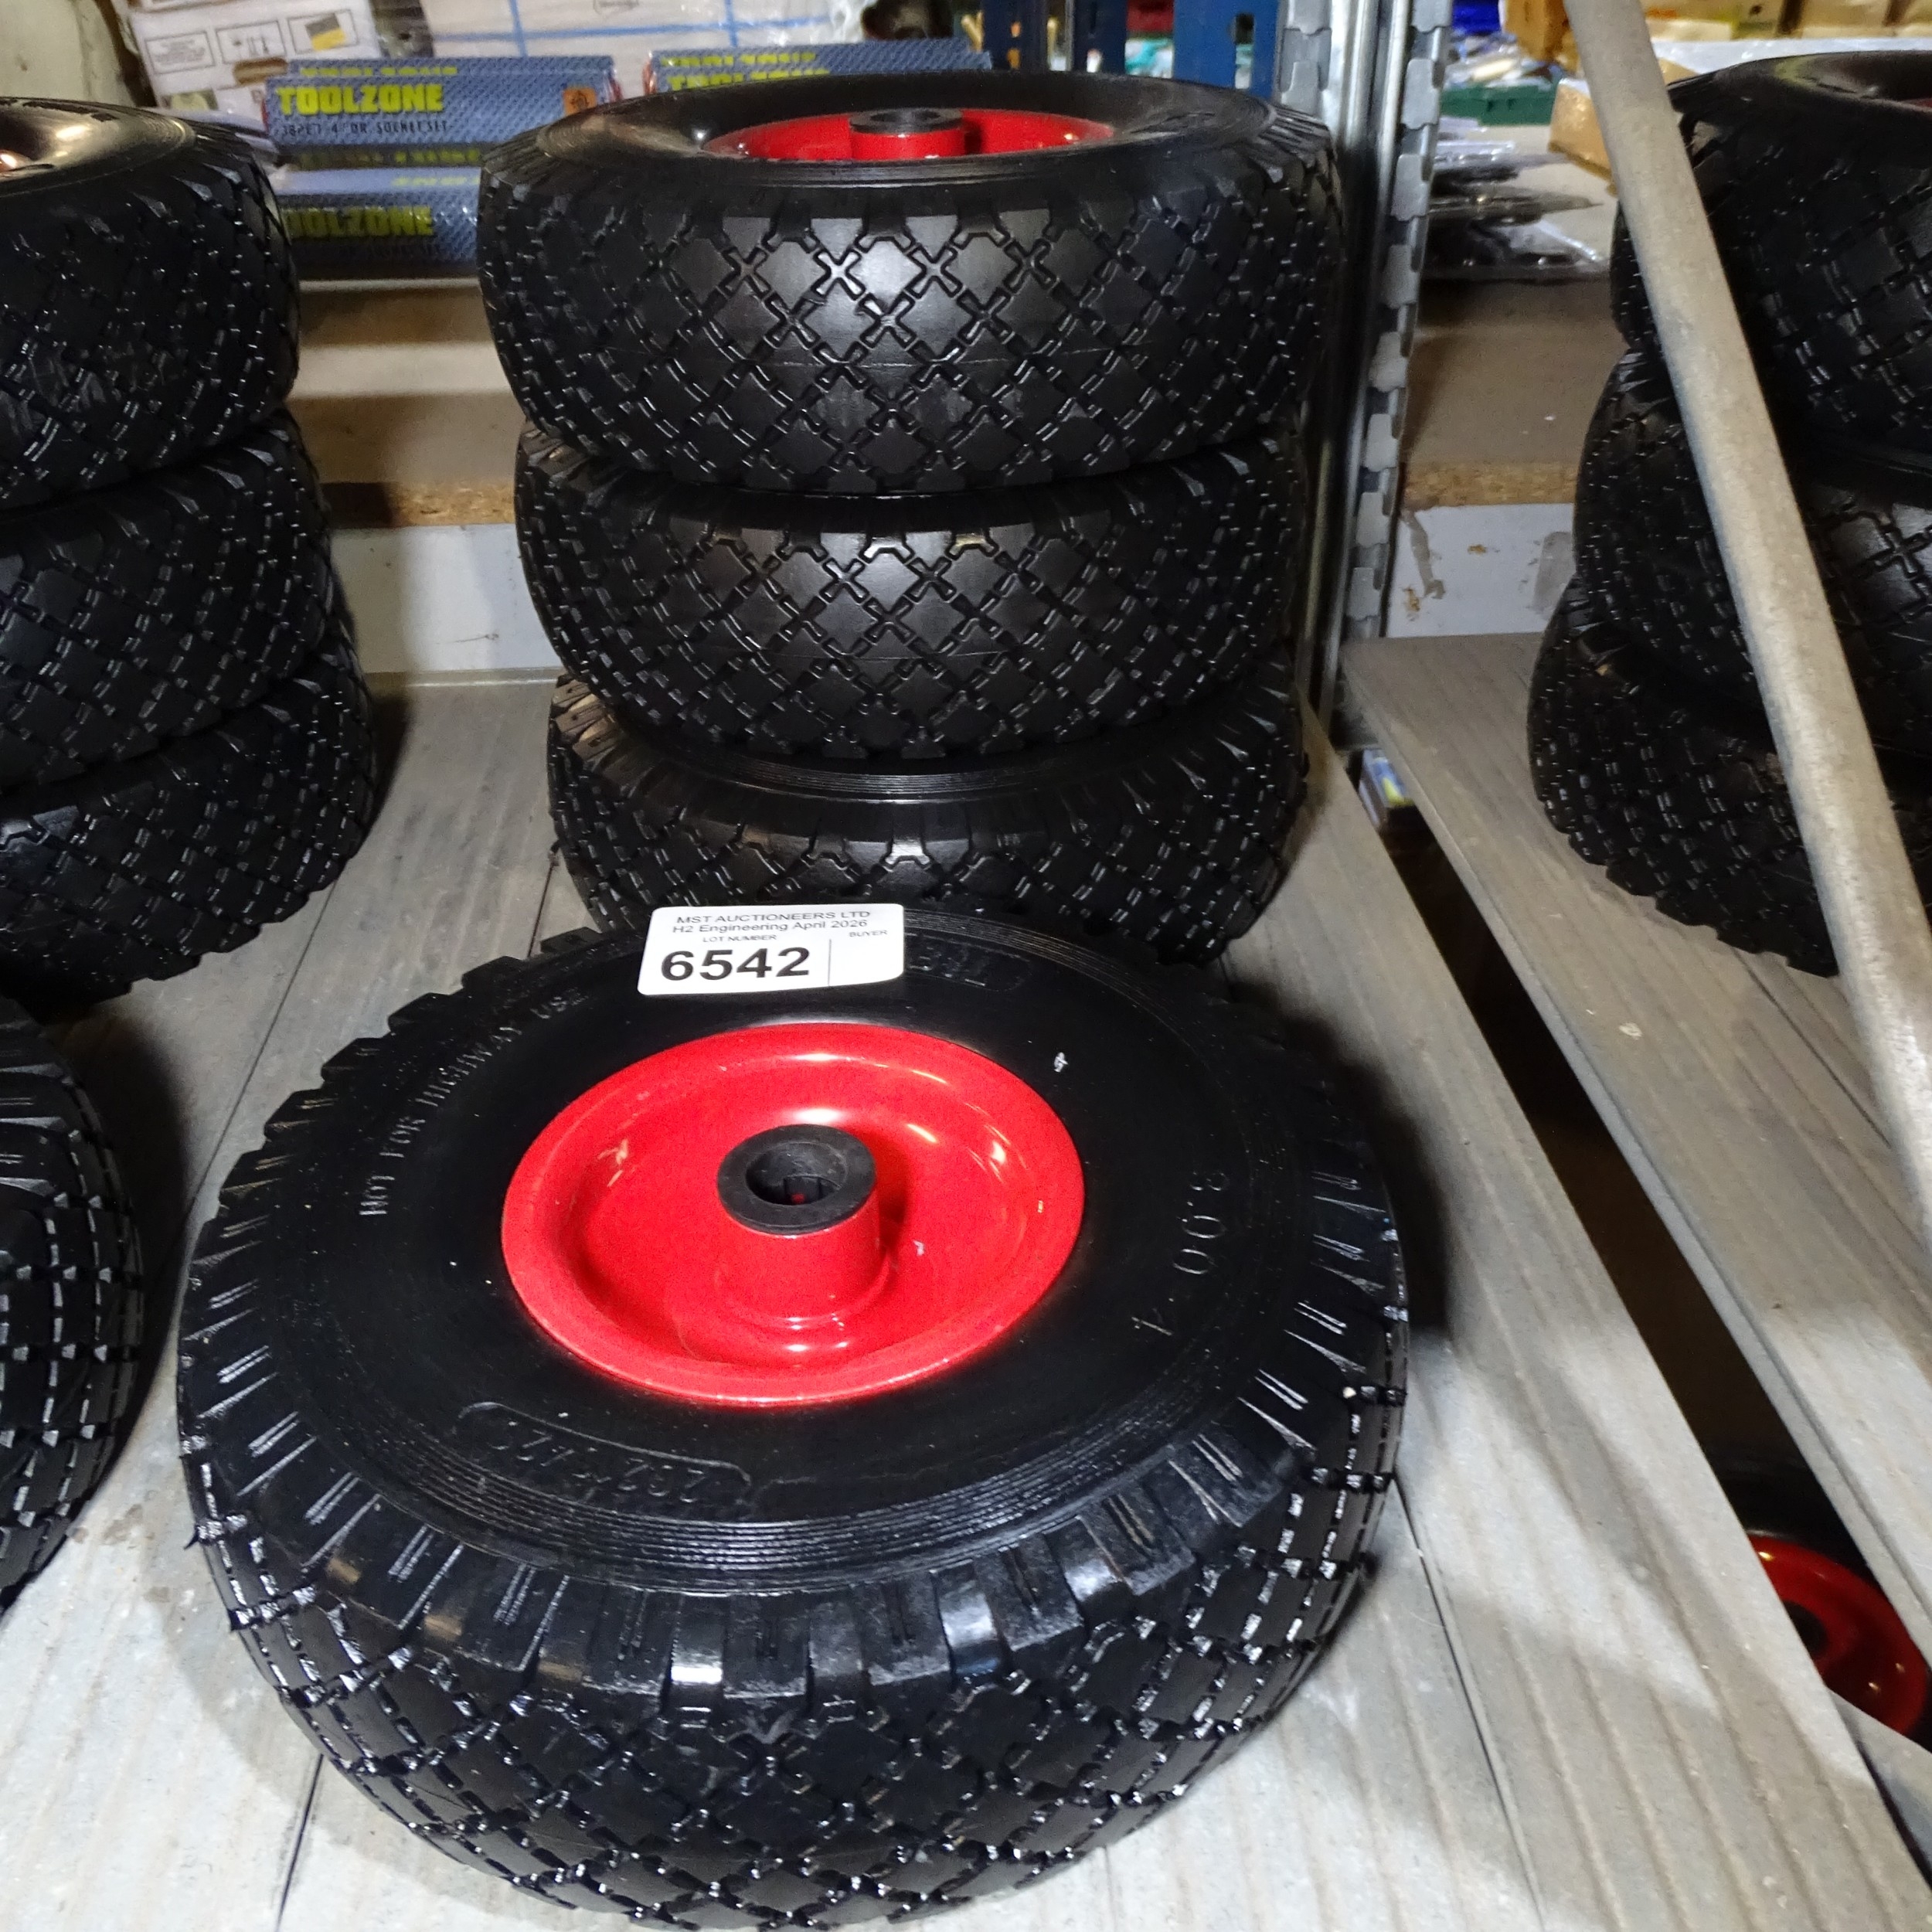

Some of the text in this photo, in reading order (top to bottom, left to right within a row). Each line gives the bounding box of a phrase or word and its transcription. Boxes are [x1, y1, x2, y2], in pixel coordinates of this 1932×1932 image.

[275, 83, 444, 115] TOOLZONE
[676, 910, 871, 924] MST AUCTIONEERS LTD
[672, 919, 868, 934] H2 Engineering April 2026
[849, 929, 889, 938] BUYER
[728, 934, 777, 942] NUMBER
[661, 947, 811, 981] 6542
